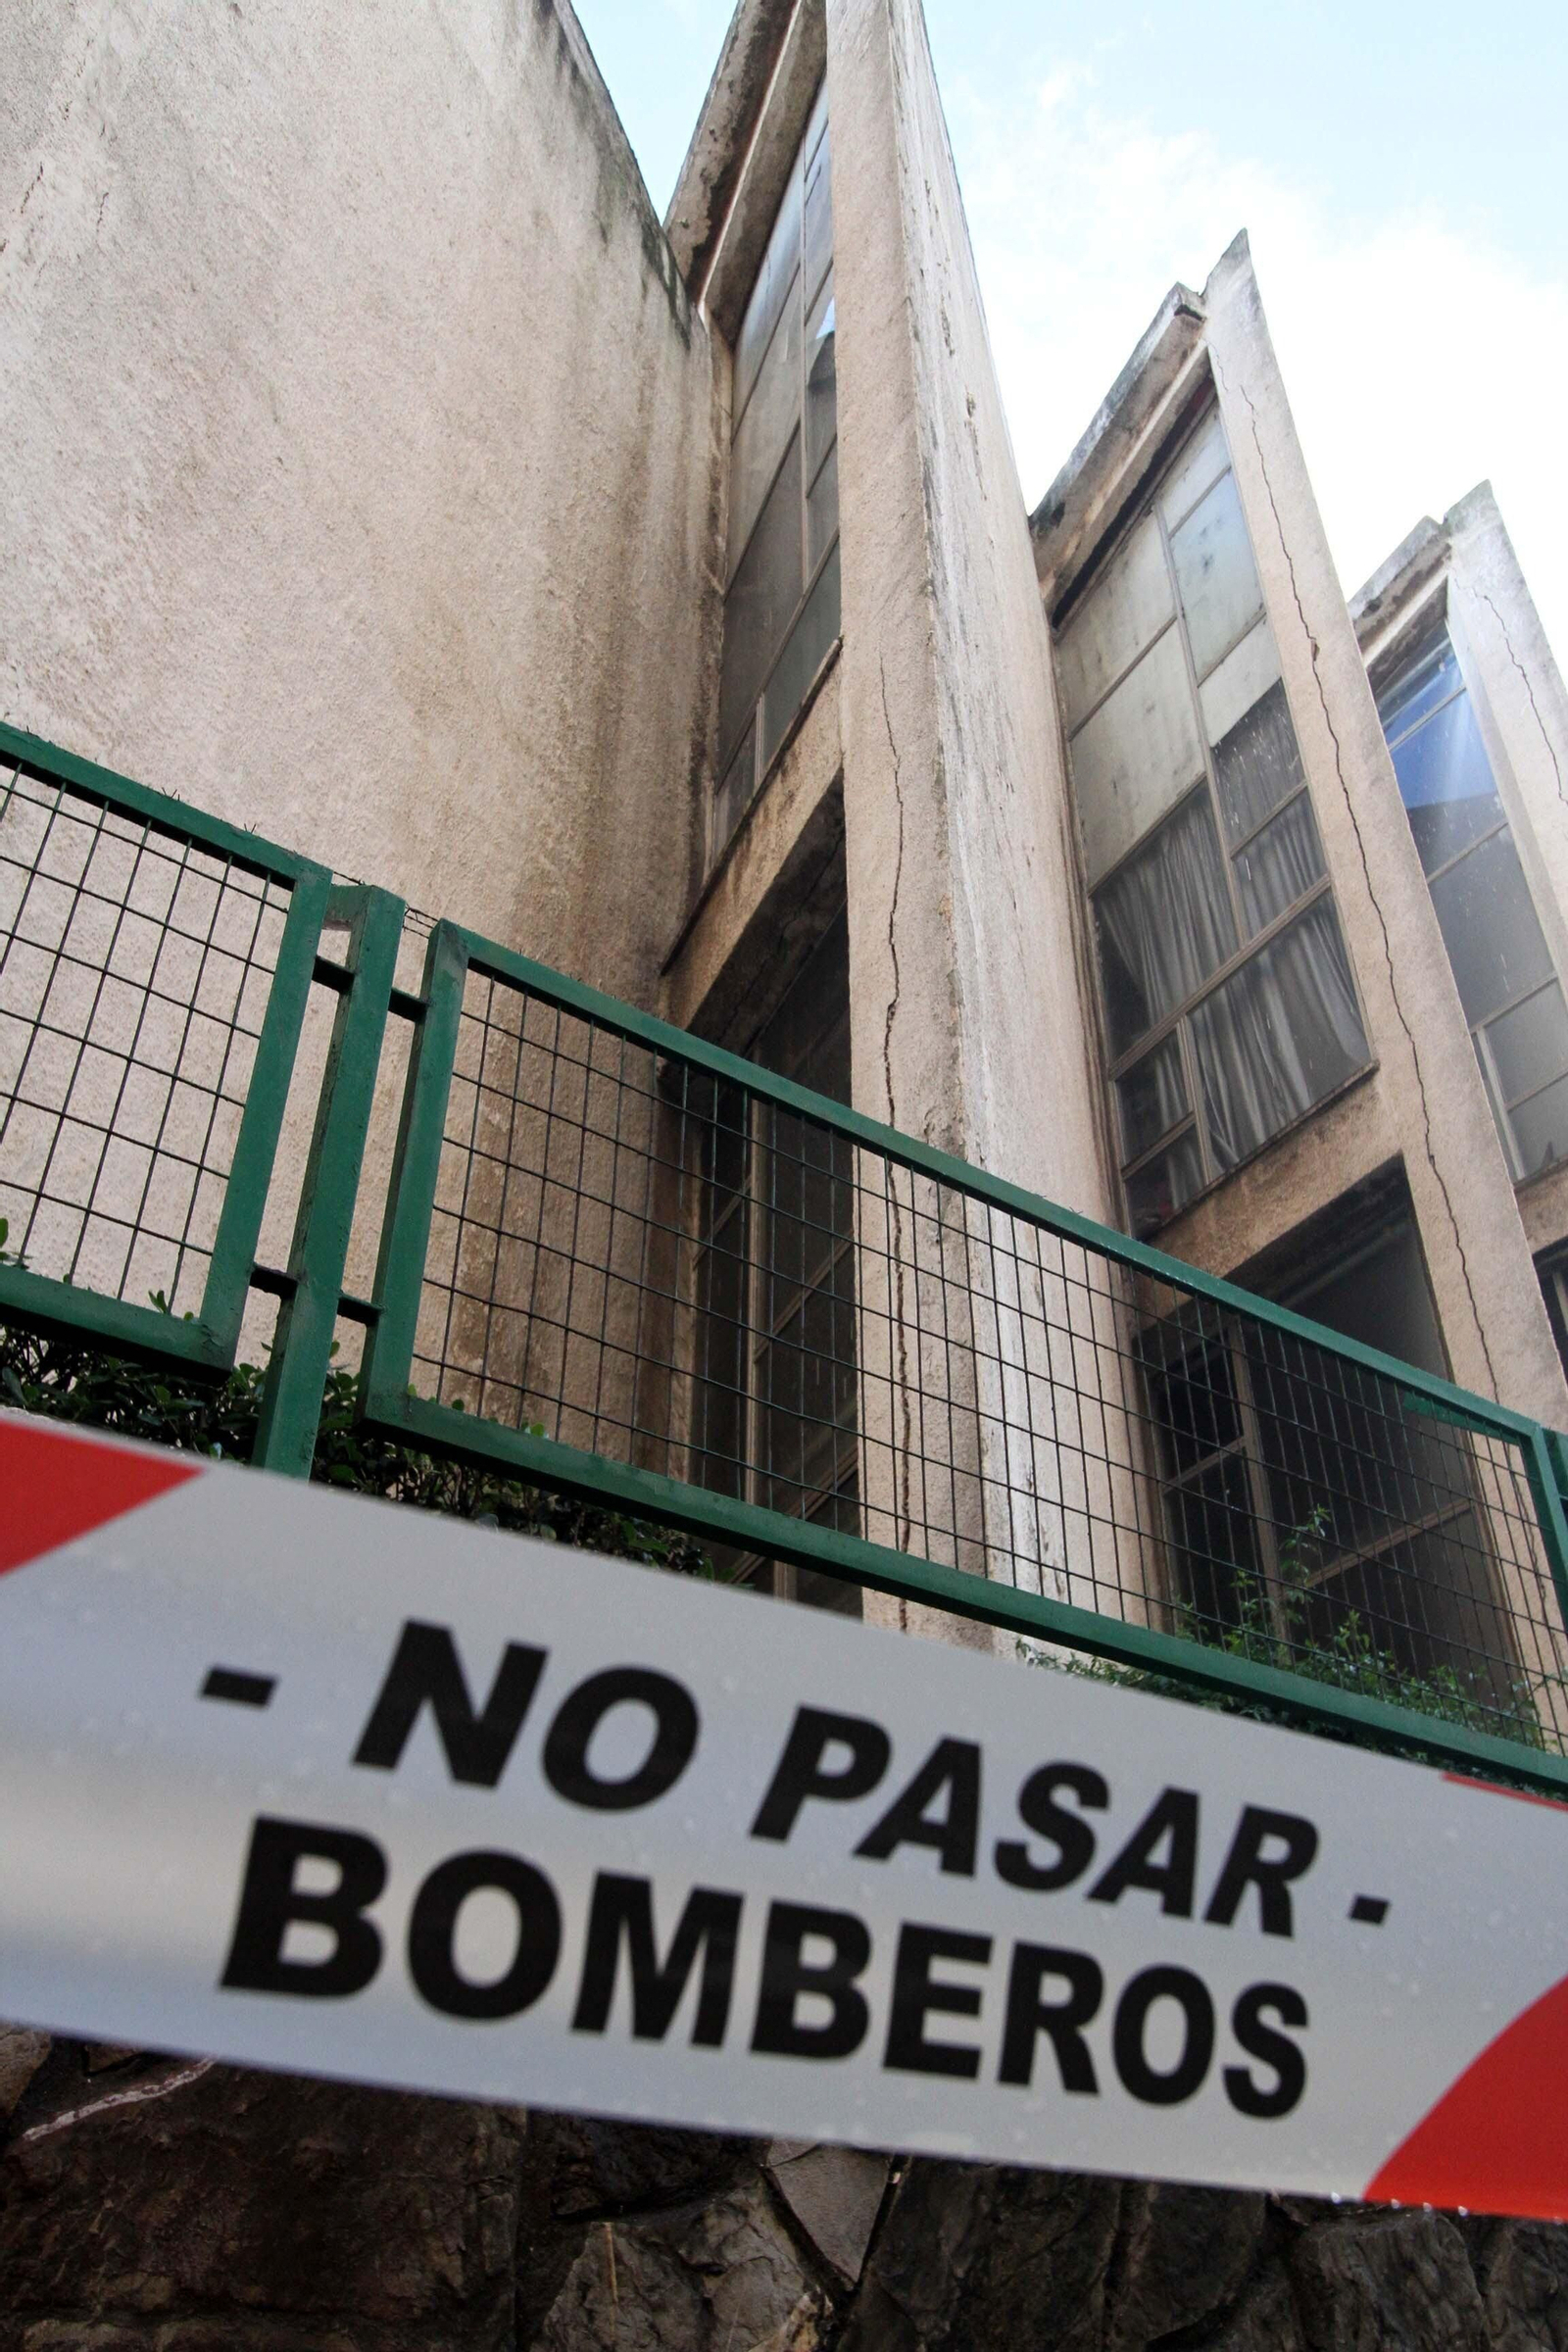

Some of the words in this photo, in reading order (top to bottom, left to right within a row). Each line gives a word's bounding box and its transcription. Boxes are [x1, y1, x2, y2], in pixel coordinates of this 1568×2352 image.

[350, 1618, 702, 1815] NO
[748, 1703, 1322, 1940] PASAR
[217, 1814, 1311, 2123] BOMBEROS
